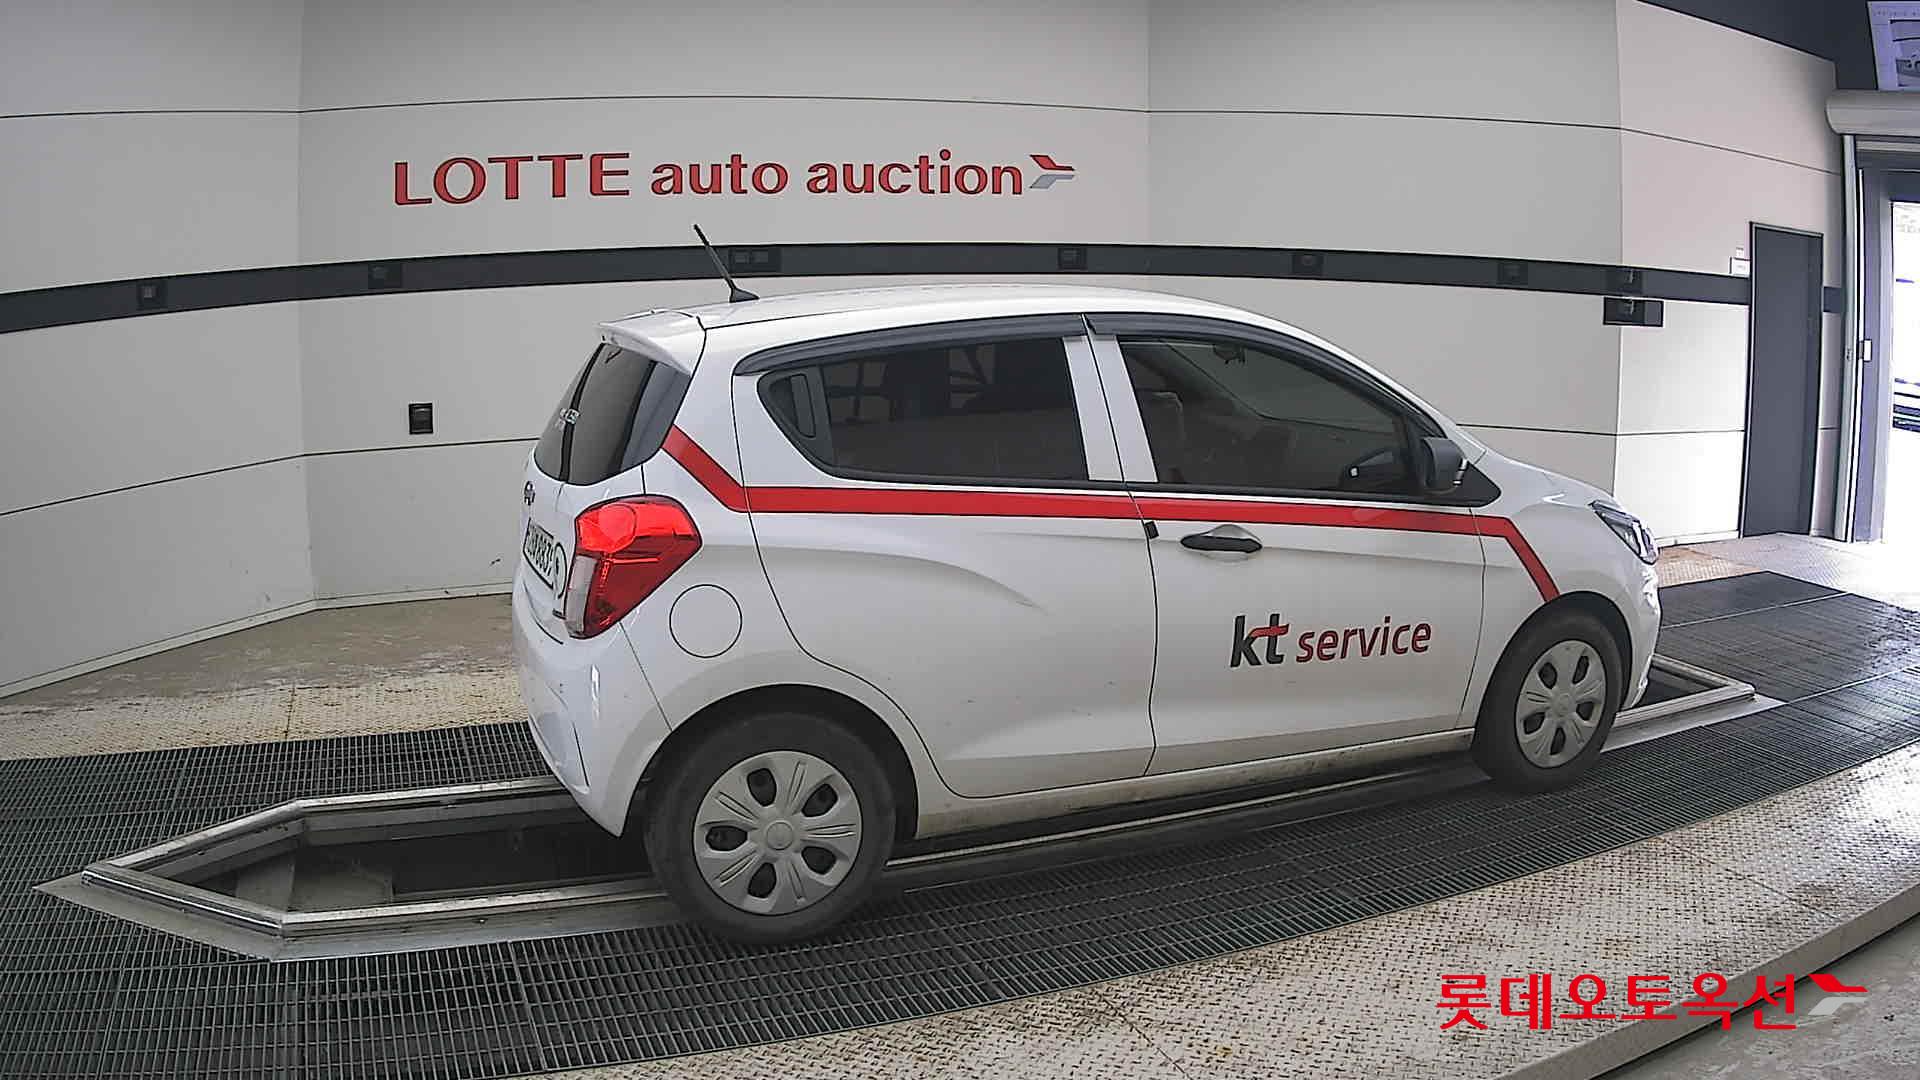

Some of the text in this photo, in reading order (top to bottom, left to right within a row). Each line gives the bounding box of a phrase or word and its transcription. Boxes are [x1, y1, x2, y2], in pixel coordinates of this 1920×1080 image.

[393, 148, 1023, 206] LOTTE auto auction
[1230, 613, 1432, 668] kt service
